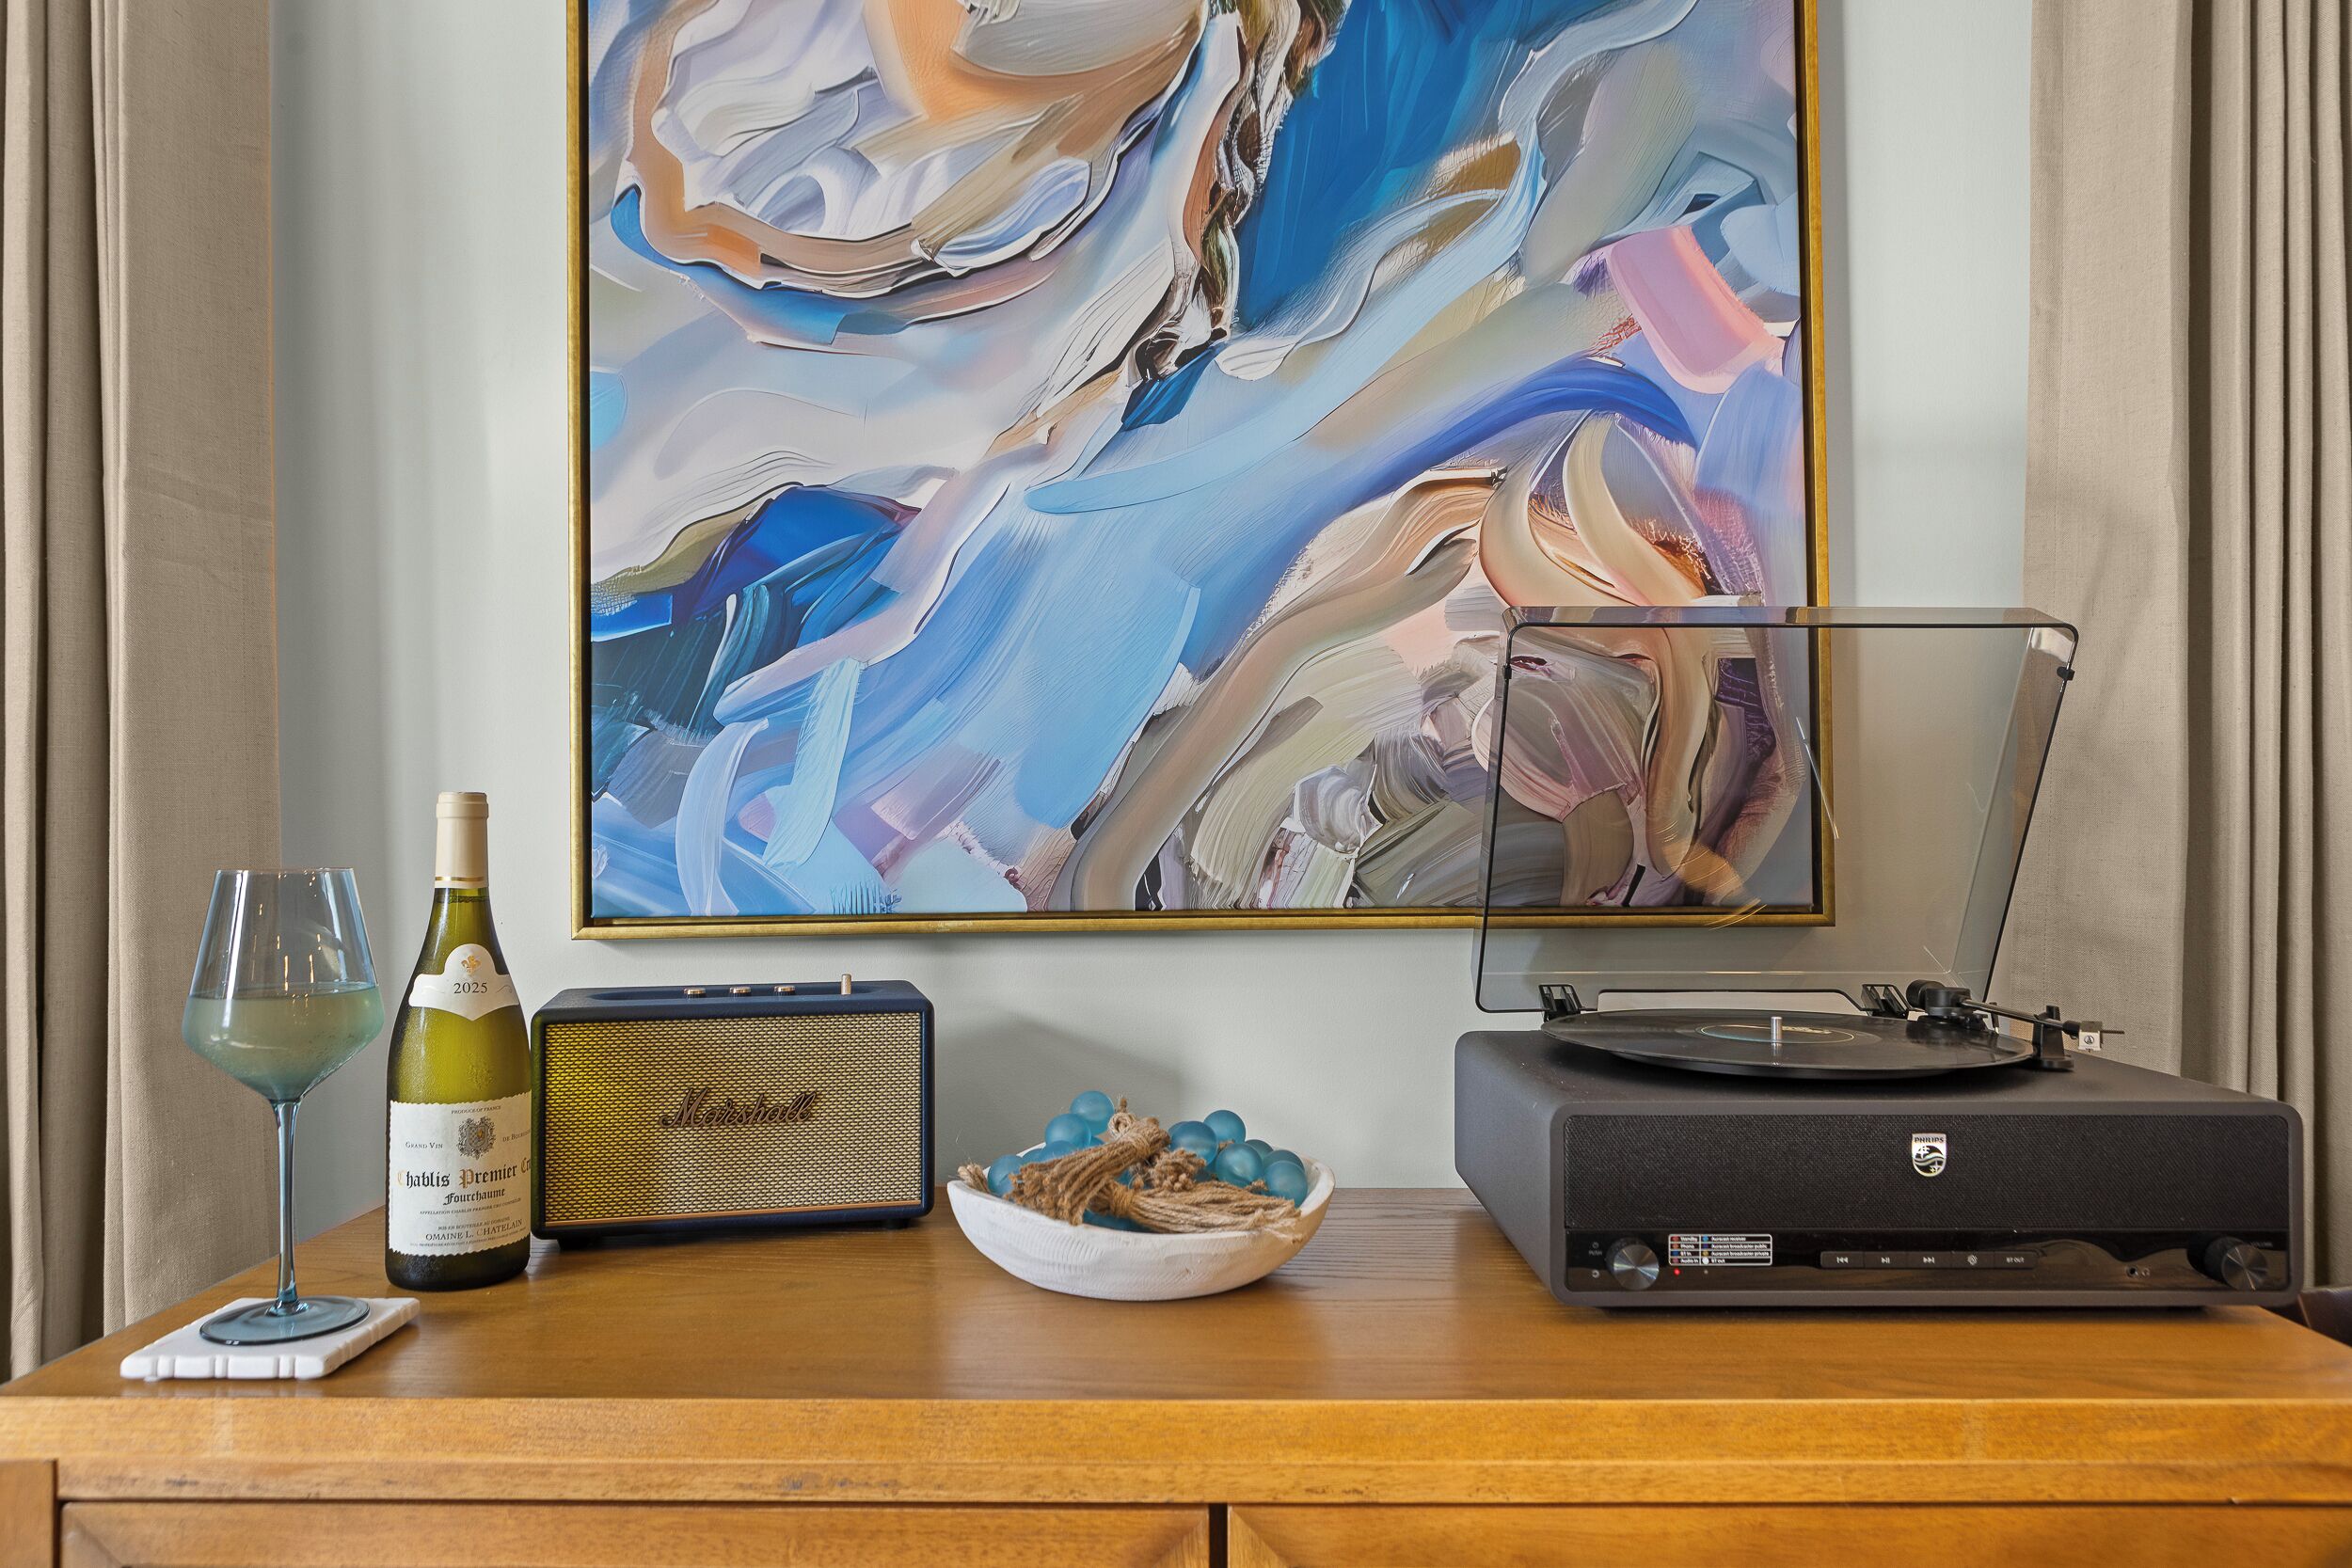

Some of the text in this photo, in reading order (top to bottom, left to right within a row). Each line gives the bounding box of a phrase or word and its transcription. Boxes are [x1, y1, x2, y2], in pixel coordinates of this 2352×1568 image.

[453, 982, 487, 994] 2025
[659, 1086, 817, 1128] Marshall
[397, 1170, 450, 1189] Chablis
[458, 1163, 517, 1189] Premier
[443, 1188, 505, 1206] Fourchaume
[421, 1231, 463, 1241] OMAINE
[476, 1218, 523, 1236] CHATELAIN
